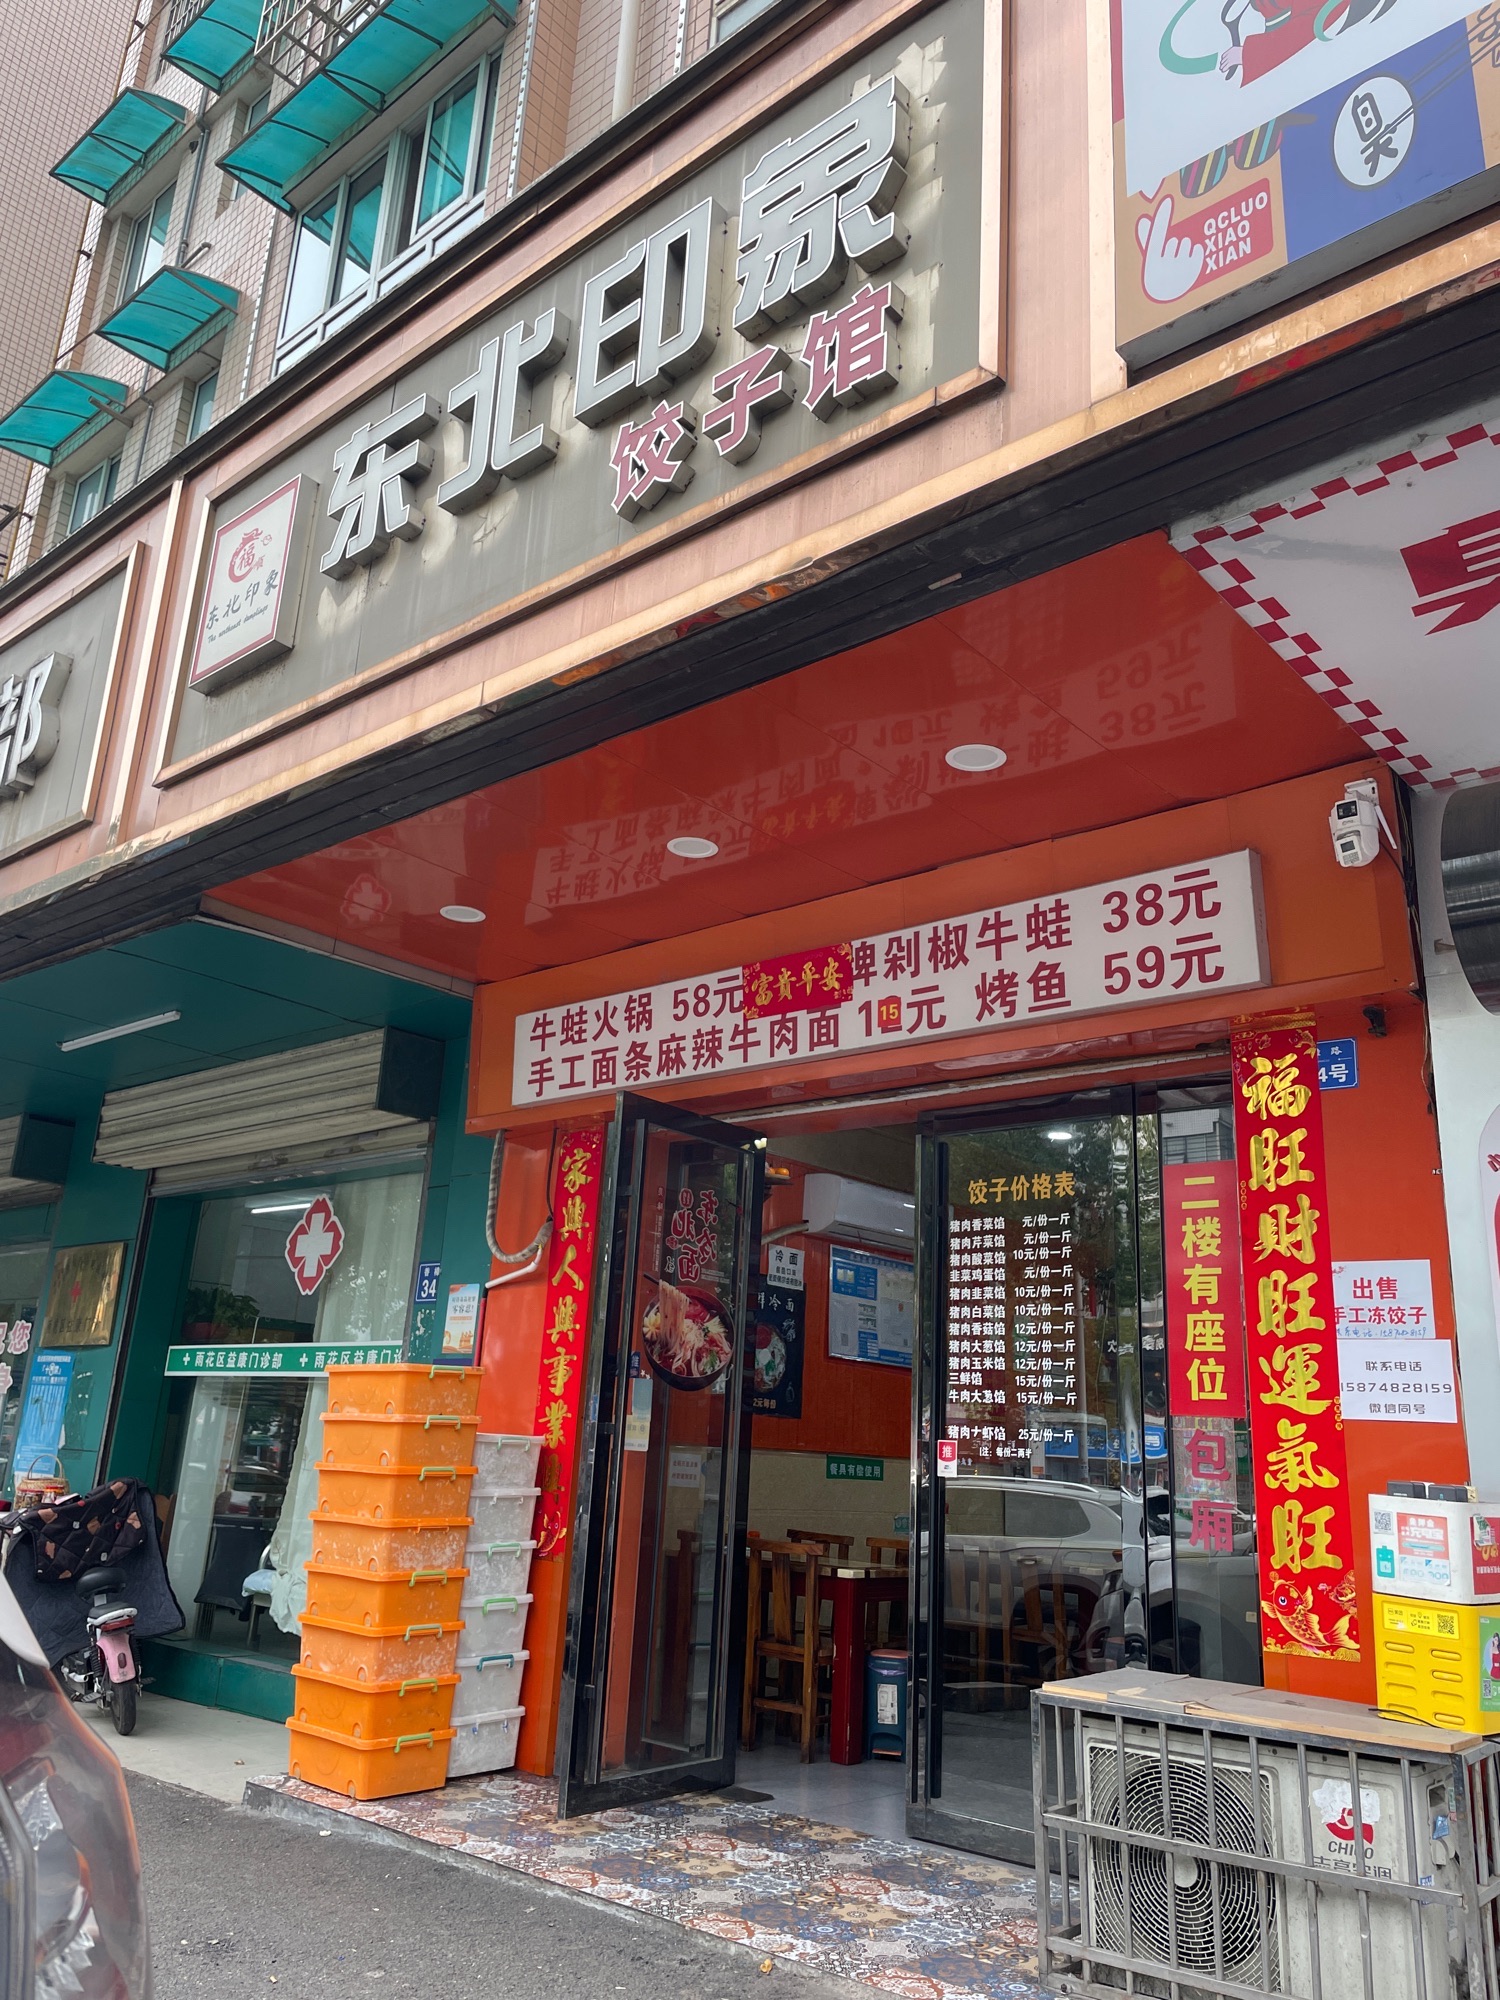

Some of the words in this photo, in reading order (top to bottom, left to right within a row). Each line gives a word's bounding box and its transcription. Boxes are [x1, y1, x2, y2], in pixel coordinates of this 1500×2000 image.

[1203, 191, 1268, 236] QCLUO
[1204, 219, 1250, 256] XIAO
[1204, 237, 1252, 275] XIAN
[320, 75, 900, 577] 东北印象
[611, 282, 895, 513] 饺子馆
[205, 568, 280, 631] 东北印象
[1102, 868, 1222, 933] 38元
[527, 1002, 841, 1098] 手工面条麻辣牛肉面
[974, 960, 1073, 1023] 烤鱼
[1103, 931, 1225, 996] 59元
[529, 991, 653, 1052] 牛蛙火锅
[673, 974, 744, 1022] 58元
[968, 1170, 1076, 1205] 饺子价格表
[949, 1216, 1005, 1233] 猪肉香菜馅
[1022, 1213, 1071, 1228] 元/份一斤
[949, 1234, 1005, 1251] 猪肉芹菜馅
[1023, 1230, 1072, 1245] 元/份一斤
[949, 1251, 1006, 1267] 猪肉酸菜馅
[1013, 1246, 1073, 1261] 10元/份一斤
[949, 1268, 1006, 1283] 韭菜鸡蛋馅
[1024, 1264, 1074, 1279] 元/份一斤
[420, 1279, 437, 1298] 34
[949, 1286, 1006, 1301] 猪肉韭菜馅
[1014, 1284, 1075, 1298] 10元/份一斤
[1181, 1175, 1228, 1401] 二楼有座位
[1352, 1276, 1399, 1300] 出售
[949, 1305, 1006, 1319] 猪肉白菜馅
[1014, 1303, 1075, 1317] 10元/份一斤
[1334, 1306, 1427, 1325] 手工冻饺子
[948, 1322, 1006, 1336] 猪肉香菇馅
[1014, 1321, 1076, 1335] 12元/份一斤
[948, 1339, 1006, 1354] 猪肉大葱馅
[1014, 1339, 1076, 1353] 12元/份一斤
[194, 1351, 283, 1370] 雨花区益康门诊部
[948, 1356, 1006, 1371] 猪肉玉米馅
[1014, 1357, 1076, 1371] 12元/份一斤
[1365, 1361, 1423, 1372] 联系电话
[948, 1372, 983, 1386] 三鲜馅
[1015, 1375, 1076, 1388] 15元/份一斤
[1340, 1382, 1453, 1394] 15874828159
[948, 1389, 1006, 1404] 牛肉大葱馅
[1016, 1392, 1077, 1405] 15元/份一斤
[1369, 1403, 1426, 1415] 微信同号
[1018, 1429, 1075, 1443] 25元/份一斤
[941, 1445, 953, 1459] 推
[829, 1463, 881, 1478] 餐具有偿使用
[1185, 1429, 1235, 1552] 包厢
[1328, 1841, 1374, 1860] CHIO
